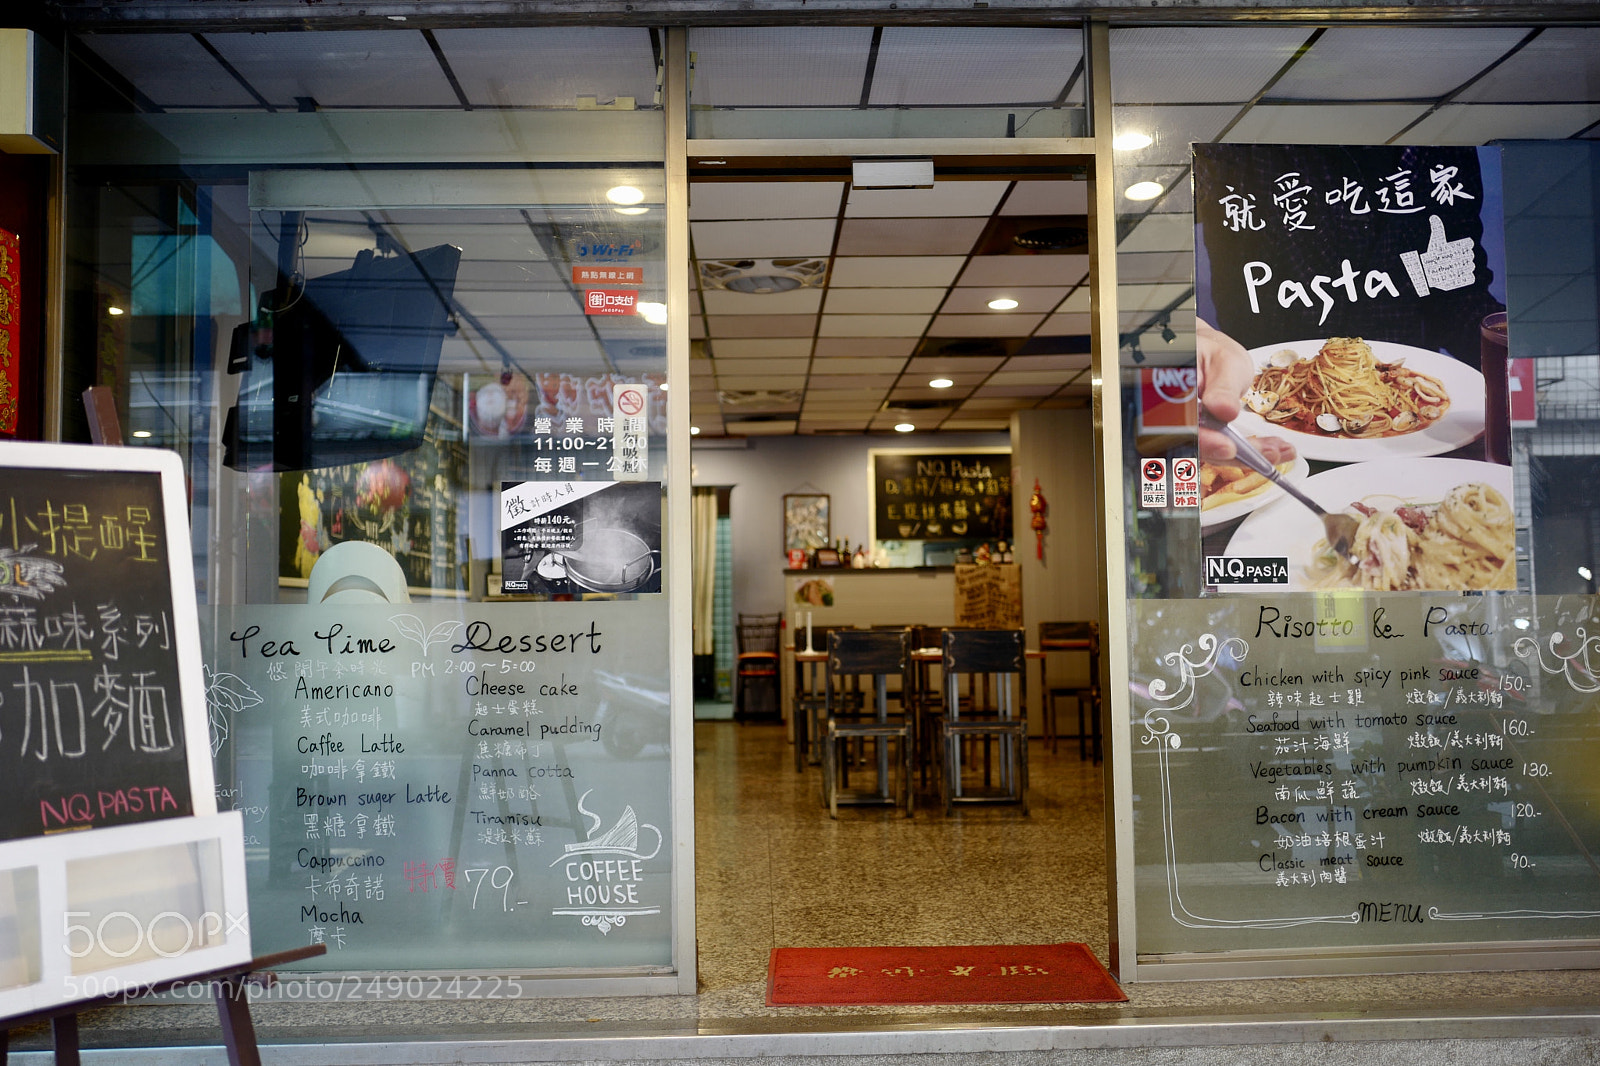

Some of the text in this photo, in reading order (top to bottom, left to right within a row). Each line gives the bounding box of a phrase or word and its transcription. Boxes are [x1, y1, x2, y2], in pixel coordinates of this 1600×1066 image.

[1219, 164, 1475, 232] 就愛吃這家
[592, 244, 634, 256] Wi-Fi
[589, 291, 634, 308] 街口支付
[1243, 259, 1400, 326] Pasta
[534, 417, 646, 435] 營業時間
[534, 456, 647, 474] 每週一公休
[1143, 482, 1165, 491] 禁止
[1175, 496, 1198, 506] 外食
[0, 497, 158, 563] 小提醒
[1247, 563, 1287, 577] PASTA
[1255, 605, 1354, 638] Risotto
[1423, 606, 1492, 638] Pasta
[230, 623, 396, 658] Tea Time
[451, 621, 602, 655] Dessert
[411, 662, 436, 679] PM
[1240, 665, 1479, 689] Chicken with spicy pink sauce
[294, 676, 394, 700] Americano
[466, 671, 579, 696] Cheese cake
[0, 663, 175, 762] 加麵
[300, 704, 383, 730] 美式咖啡
[474, 699, 544, 717] 起士蛋糕
[467, 716, 602, 741] Caramel pudding
[1246, 710, 1457, 733] Seafood with tomato sauce
[297, 733, 405, 755] Caffee Latte
[476, 740, 543, 760] 焦糖布丁
[1274, 731, 1350, 756] 茄汁海鮮
[301, 758, 396, 784] 咖啡拿鐵
[473, 764, 575, 782] Panna cotta
[1250, 752, 1514, 783] Vegetables with pumpkin sauce
[99, 786, 178, 820] PASTA
[296, 783, 452, 812] Brown suger Latte
[478, 782, 541, 803] 鮮奶酪
[1274, 779, 1361, 804] 南瓜鮮蔬
[470, 811, 543, 827] Tiramisu
[1256, 804, 1460, 825] Bacon with cream sauce
[303, 813, 396, 840] 黑糖拿鐵
[477, 828, 545, 847] 提拉米蘇
[1273, 830, 1386, 850] 奶油培根蛋汁
[297, 848, 385, 874] Cappuccino
[566, 860, 644, 882] COFFEE
[1259, 852, 1404, 872] Classic meat sauce
[305, 872, 385, 901] 卡布奇諾
[403, 858, 457, 893] 特價
[1275, 866, 1347, 888] 義大利肉醬
[567, 884, 639, 905] HOUSE
[301, 901, 364, 924] Mocha
[1358, 902, 1424, 924] MENU
[308, 925, 347, 950] 摩卡
